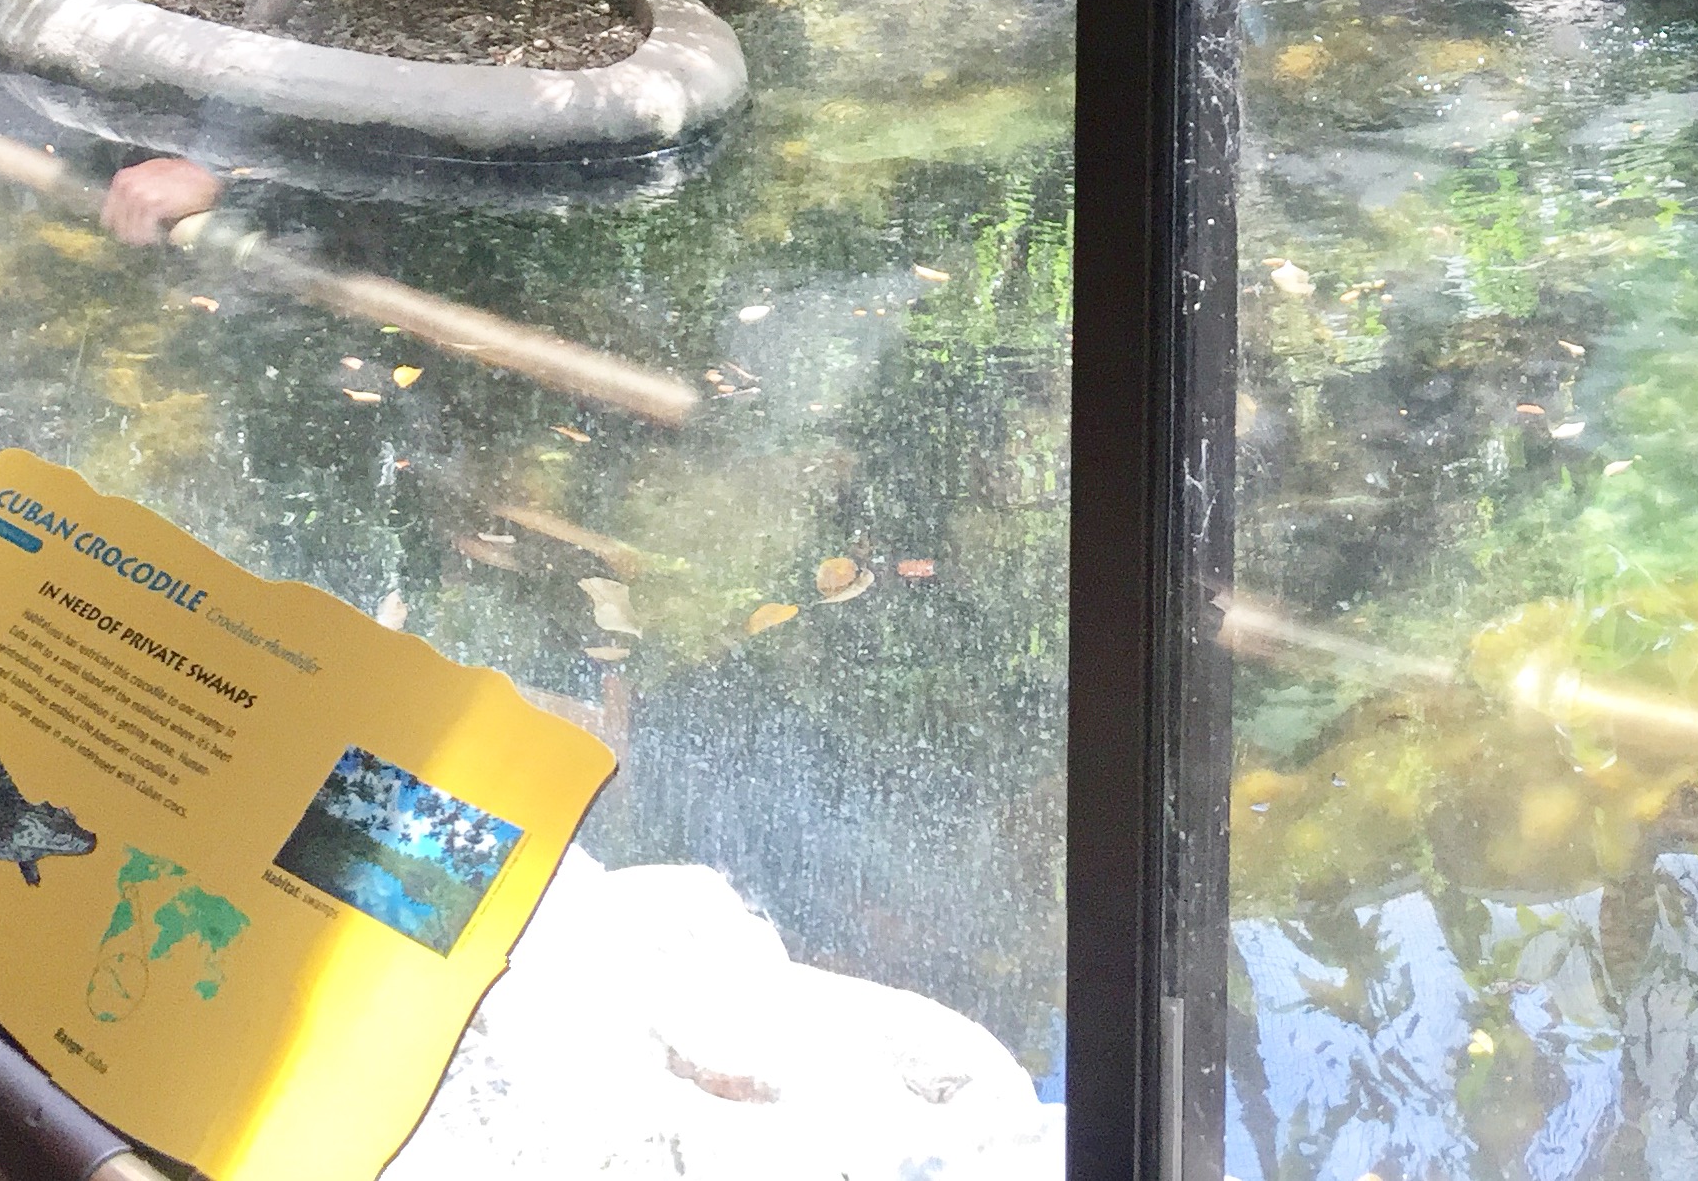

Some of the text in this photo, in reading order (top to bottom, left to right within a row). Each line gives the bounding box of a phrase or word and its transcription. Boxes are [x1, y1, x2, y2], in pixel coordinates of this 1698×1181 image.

[74, 533, 209, 613] CROCODILE
[38, 580, 62, 599] IN
[120, 627, 189, 672] PRIVATE
[186, 664, 258, 709] SWAMPS
[45, 674, 64, 687] And
[61, 683, 77, 697] the
[117, 720, 149, 743] getting
[113, 664, 130, 680] this
[129, 676, 168, 700] crocodile
[78, 720, 94, 736] the
[90, 729, 130, 756] American
[130, 753, 168, 778] crocodile
[102, 681, 119, 696] off
[115, 691, 131, 705] the
[170, 723, 195, 742] where
[210, 743, 232, 763] been
